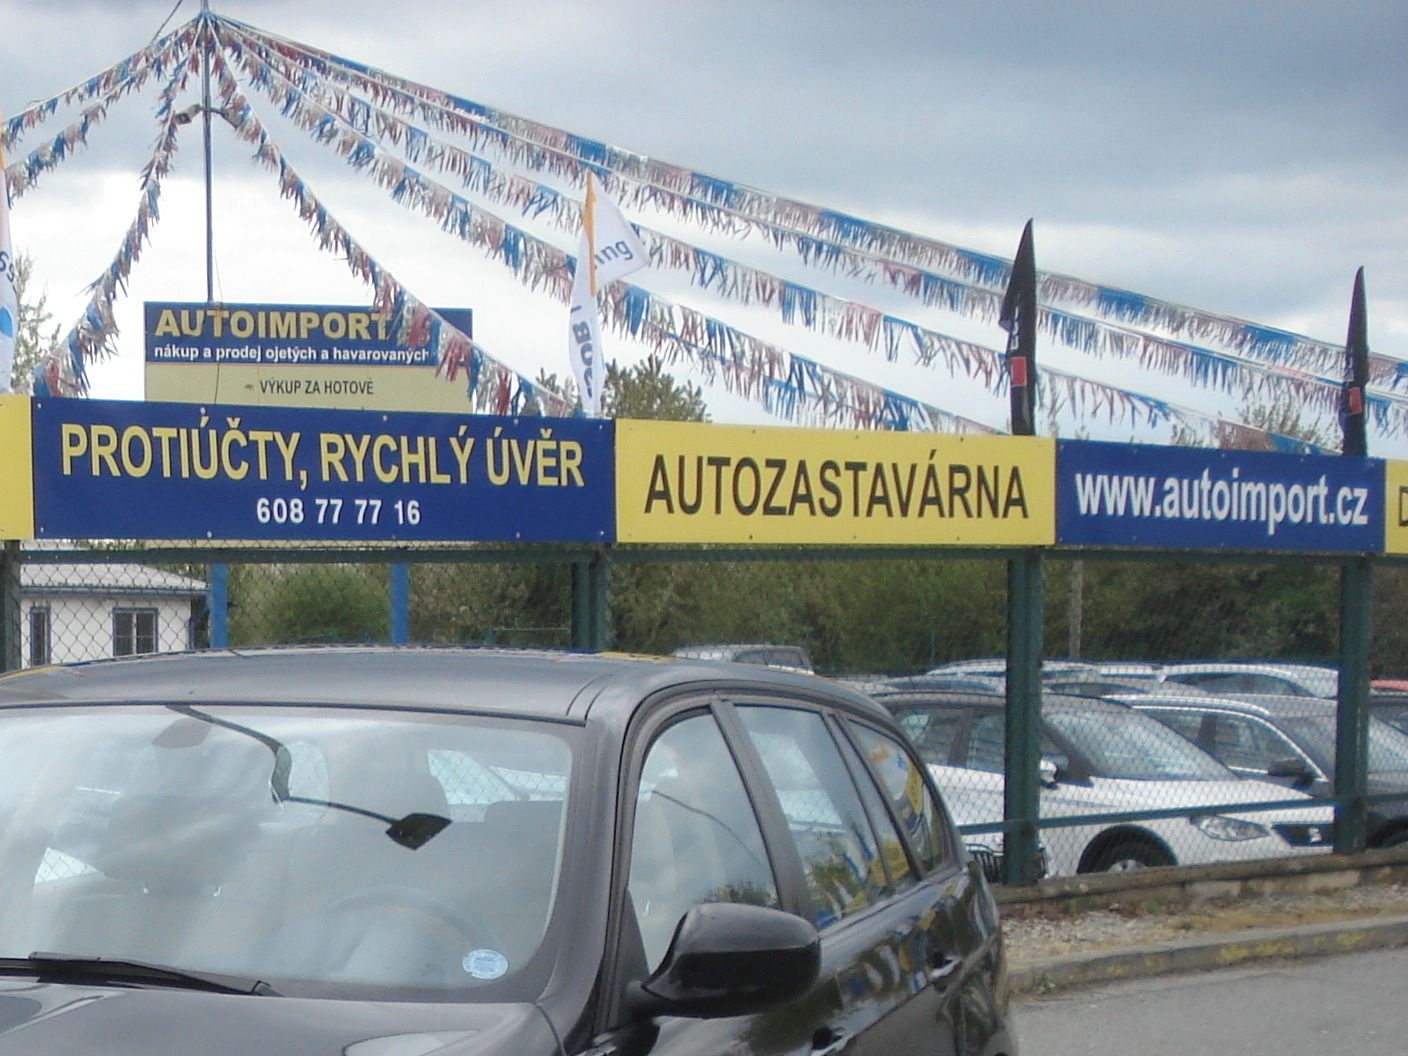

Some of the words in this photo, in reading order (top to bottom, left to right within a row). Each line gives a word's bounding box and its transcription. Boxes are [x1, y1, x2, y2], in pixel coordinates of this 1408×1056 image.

[154, 308, 393, 341] AUTOIMPORT
[154, 344, 199, 361] nákup
[203, 347, 212, 358] a
[216, 345, 261, 362] prodej
[265, 345, 317, 364] ojetých
[321, 349, 329, 360] a
[333, 346, 429, 364] havarovaných
[259, 376, 301, 394] VÝKUP
[305, 380, 321, 394] ZA
[324, 377, 374, 395] HOTOVÉ
[61, 415, 308, 491] PROTIÚČTY,
[319, 425, 475, 485] RYCHLÝ
[486, 426, 585, 487] ÚVĚR
[643, 449, 1030, 519] AUTOZASTAVÁRNA
[255, 497, 305, 524] 608
[315, 498, 343, 525] 77
[355, 499, 382, 525] 77
[394, 500, 421, 525] 16
[1075, 467, 1369, 536] www.autoimport.cz
